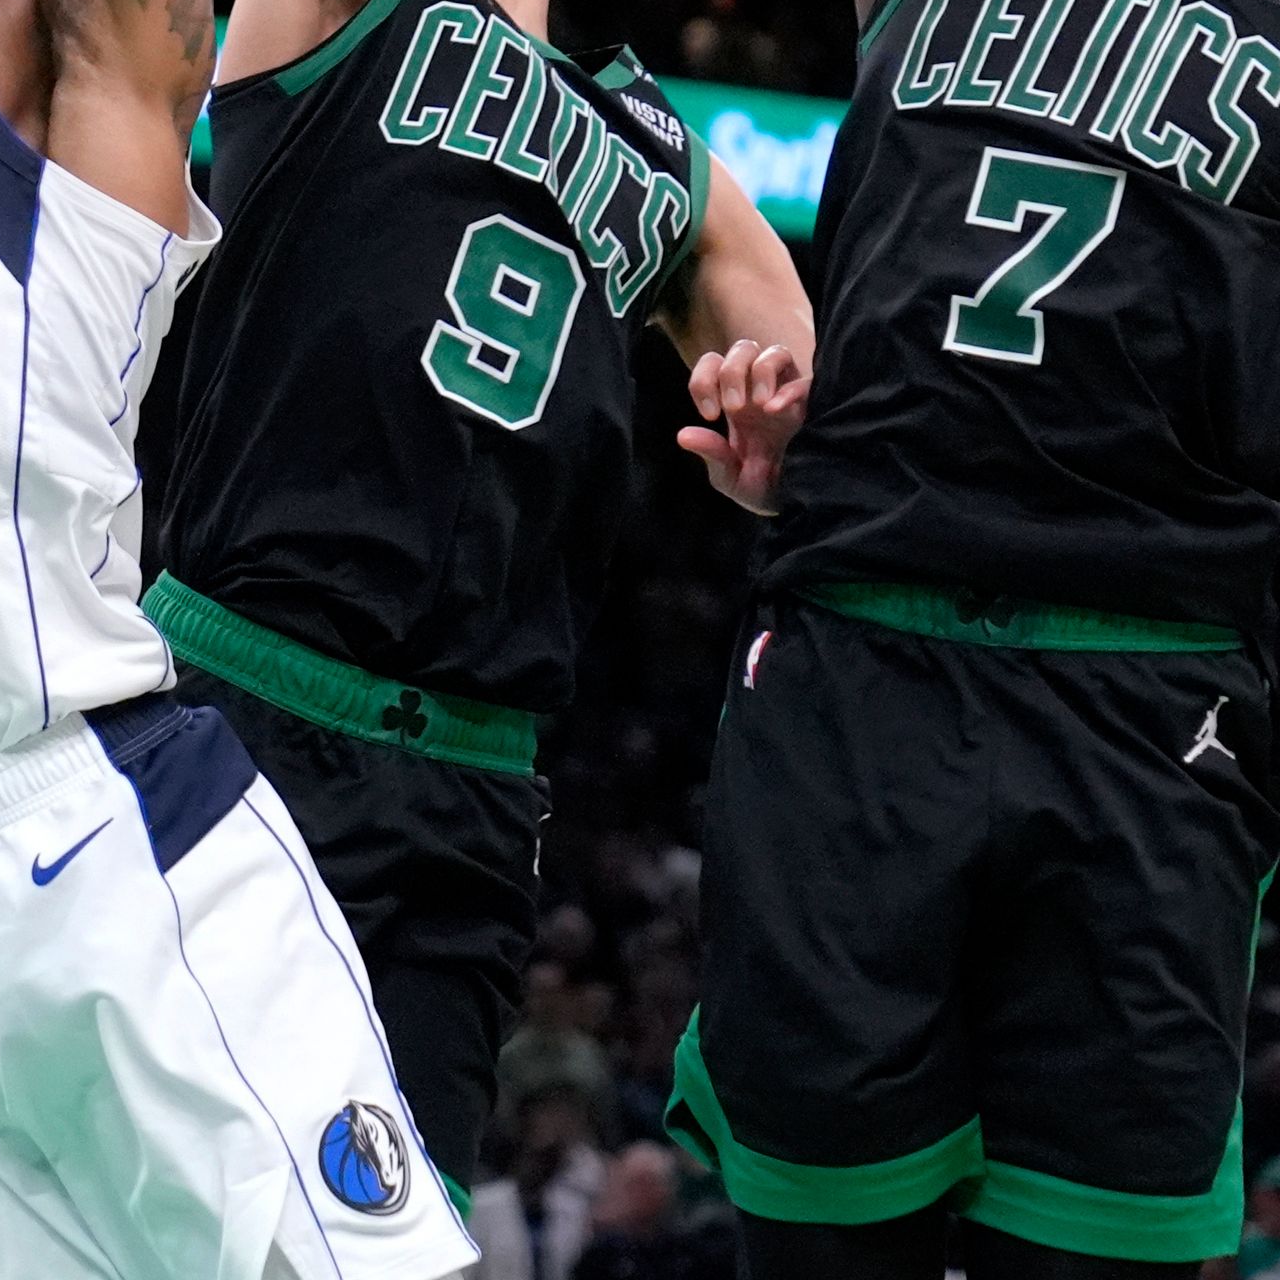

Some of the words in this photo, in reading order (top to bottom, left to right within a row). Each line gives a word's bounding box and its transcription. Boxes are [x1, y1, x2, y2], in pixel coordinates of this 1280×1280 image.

[378, 0, 690, 319] CELTICS
[620, 91, 685, 137] VISTA
[421, 213, 587, 431] 9
[942, 146, 1127, 366] 7
